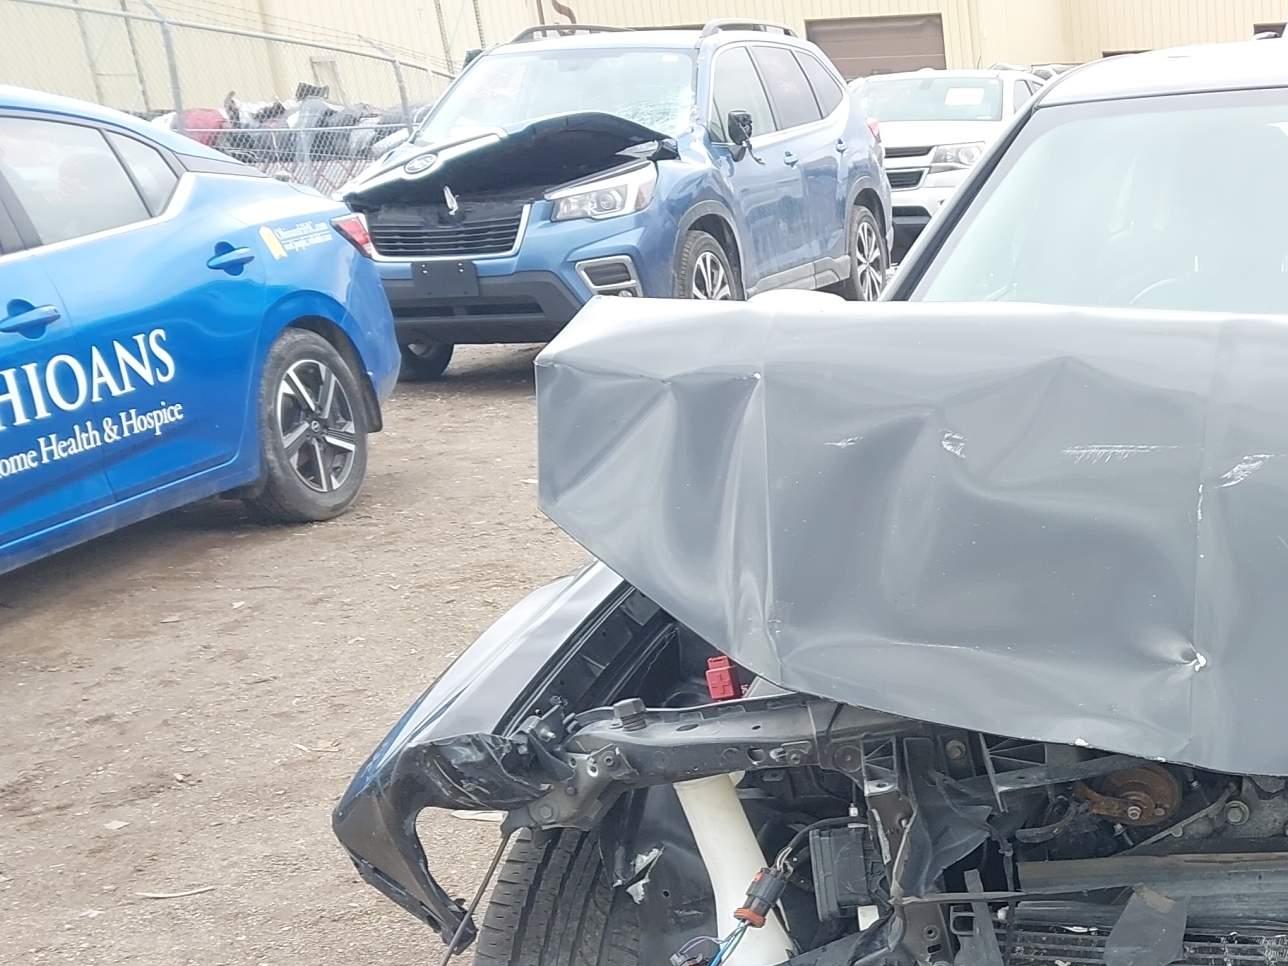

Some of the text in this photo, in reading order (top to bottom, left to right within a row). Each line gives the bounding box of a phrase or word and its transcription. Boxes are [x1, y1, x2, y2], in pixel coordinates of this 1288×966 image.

[0, 401, 184, 478] ome Health & Hospice
